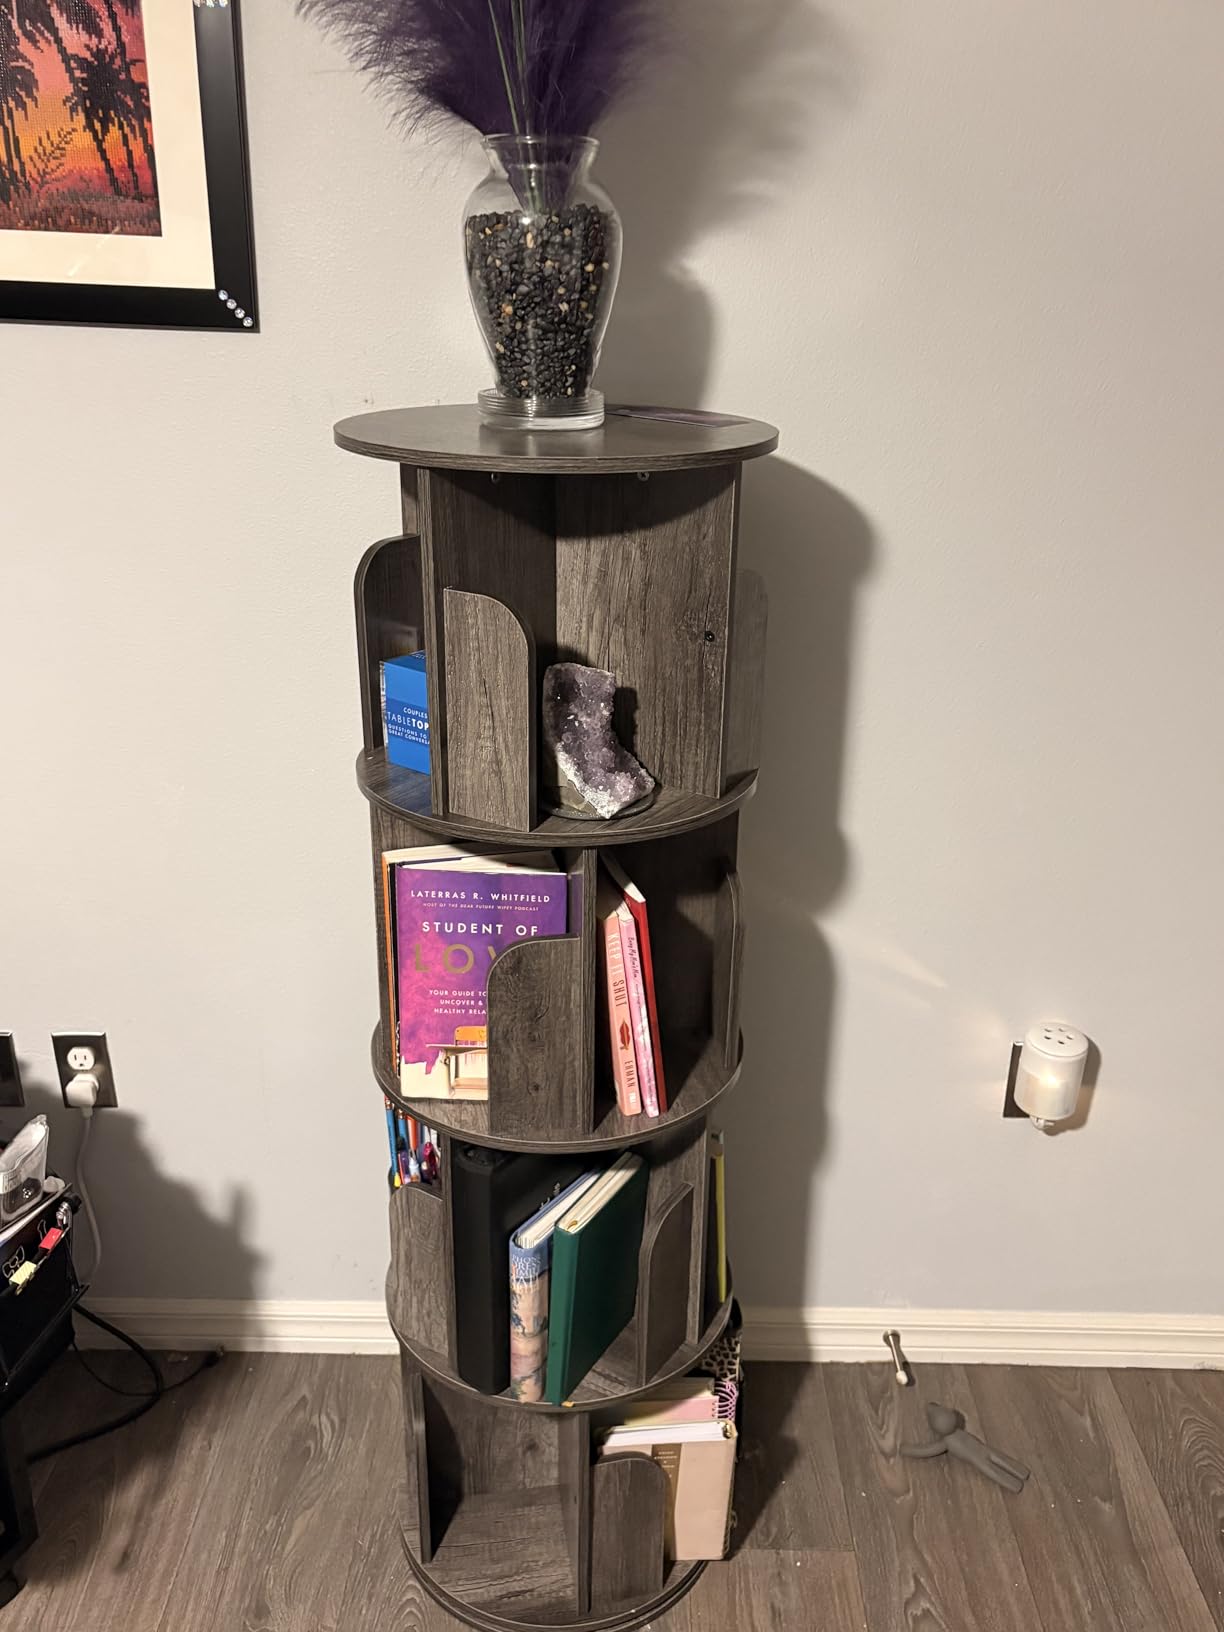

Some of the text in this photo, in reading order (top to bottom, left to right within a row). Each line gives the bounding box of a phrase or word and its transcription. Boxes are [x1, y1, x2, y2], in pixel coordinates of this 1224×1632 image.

[403, 707, 428, 719] COUPLES
[388, 723, 418, 737] QUESTIONS
[388, 728, 404, 737] GREAT
[411, 890, 466, 899] LATERRAS
[491, 893, 550, 903] WHITFIELD
[422, 921, 538, 936] STUDENT OF
[607, 932, 621, 960] KEEP
[612, 979, 627, 1007] SHUT
